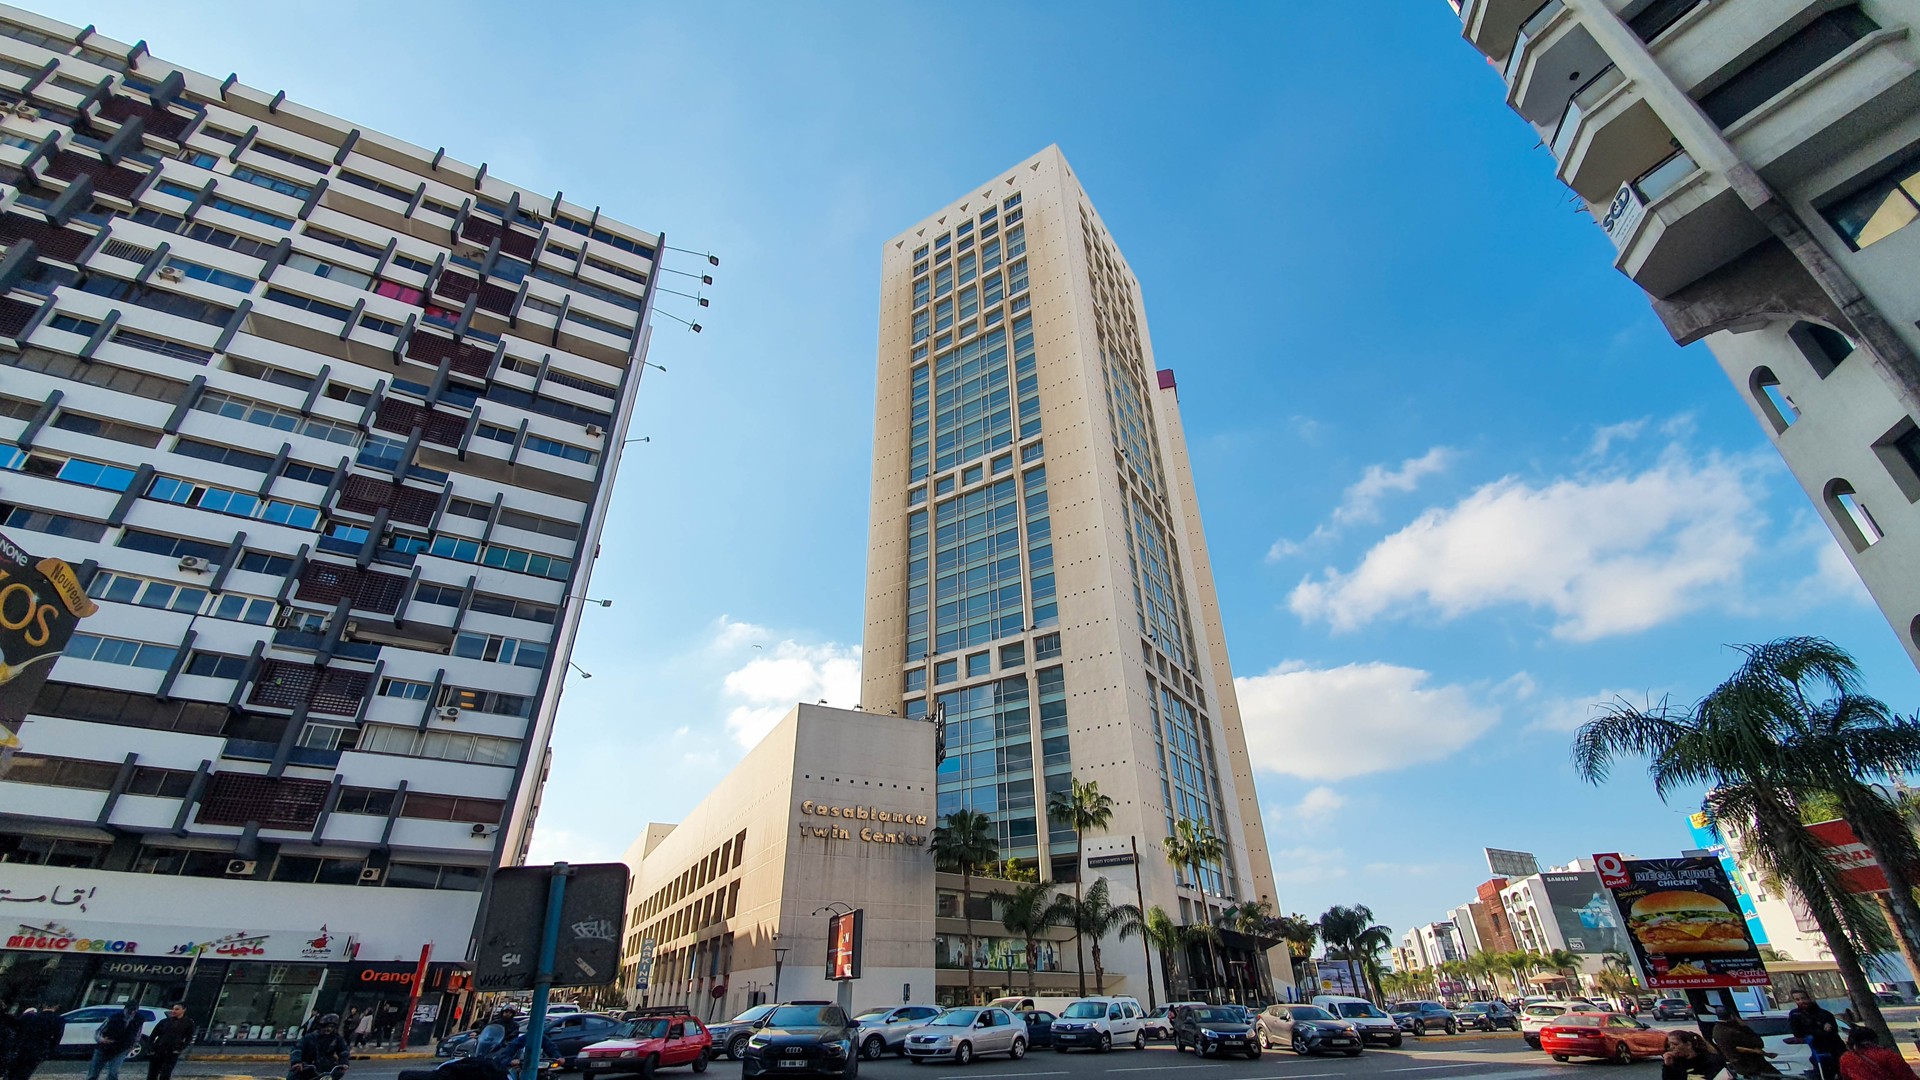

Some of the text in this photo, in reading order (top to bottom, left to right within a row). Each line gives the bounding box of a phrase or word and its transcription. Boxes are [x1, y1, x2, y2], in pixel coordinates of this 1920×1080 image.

[50, 562, 84, 612] Nouveau
[0, 569, 60, 647] OS
[801, 800, 928, 826] Casablanca
[799, 822, 927, 846] Twin Center
[1605, 877, 1628, 886] Quick
[1657, 878, 1698, 887] CHICKEN
[75, 938, 138, 953] COLOR
[638, 939, 653, 984] PARKING
[1737, 968, 1766, 977] Quick
